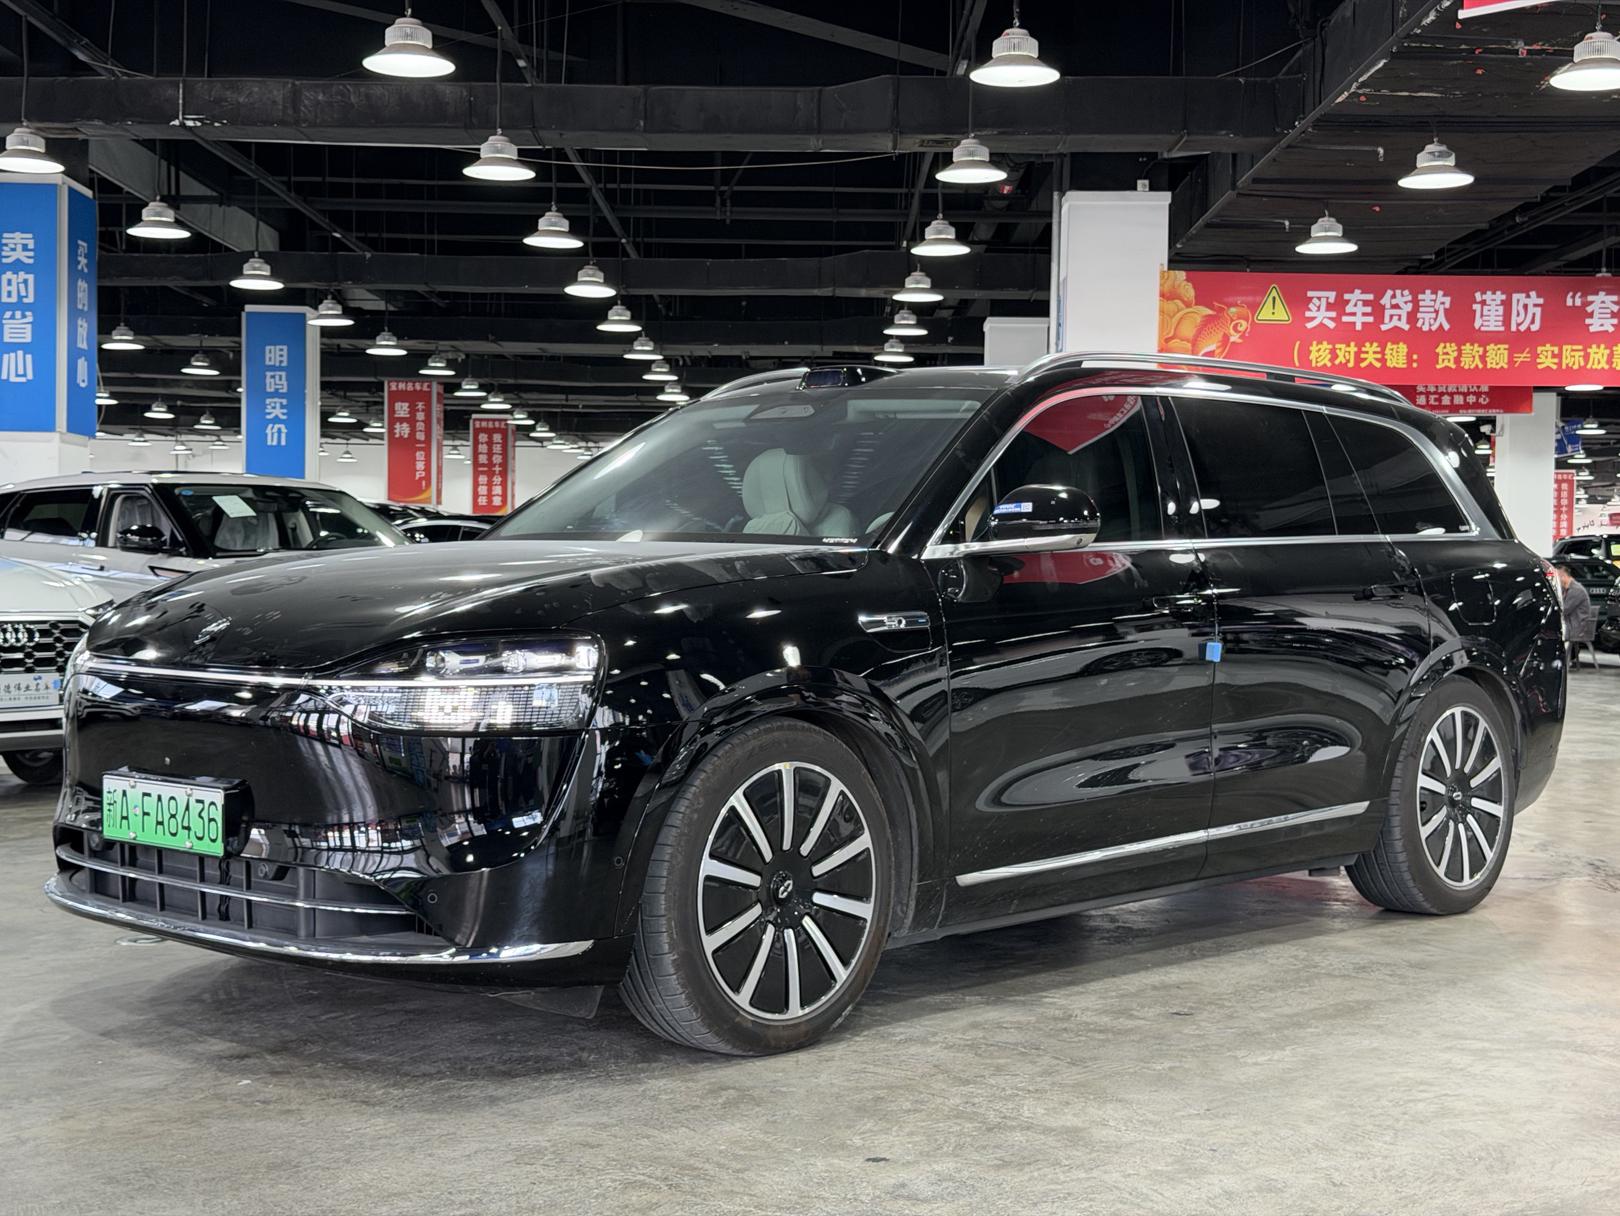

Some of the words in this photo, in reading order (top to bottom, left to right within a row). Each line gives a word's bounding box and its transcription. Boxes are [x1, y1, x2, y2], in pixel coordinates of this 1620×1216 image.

[1, 232, 35, 383] 卖的省心
[76, 239, 89, 388] 买的放心
[1304, 289, 1451, 332] 买车贷款
[265, 344, 288, 446] 明码实价
[393, 402, 411, 439] 坚持
[1416, 394, 1489, 405] 通汇金融中心
